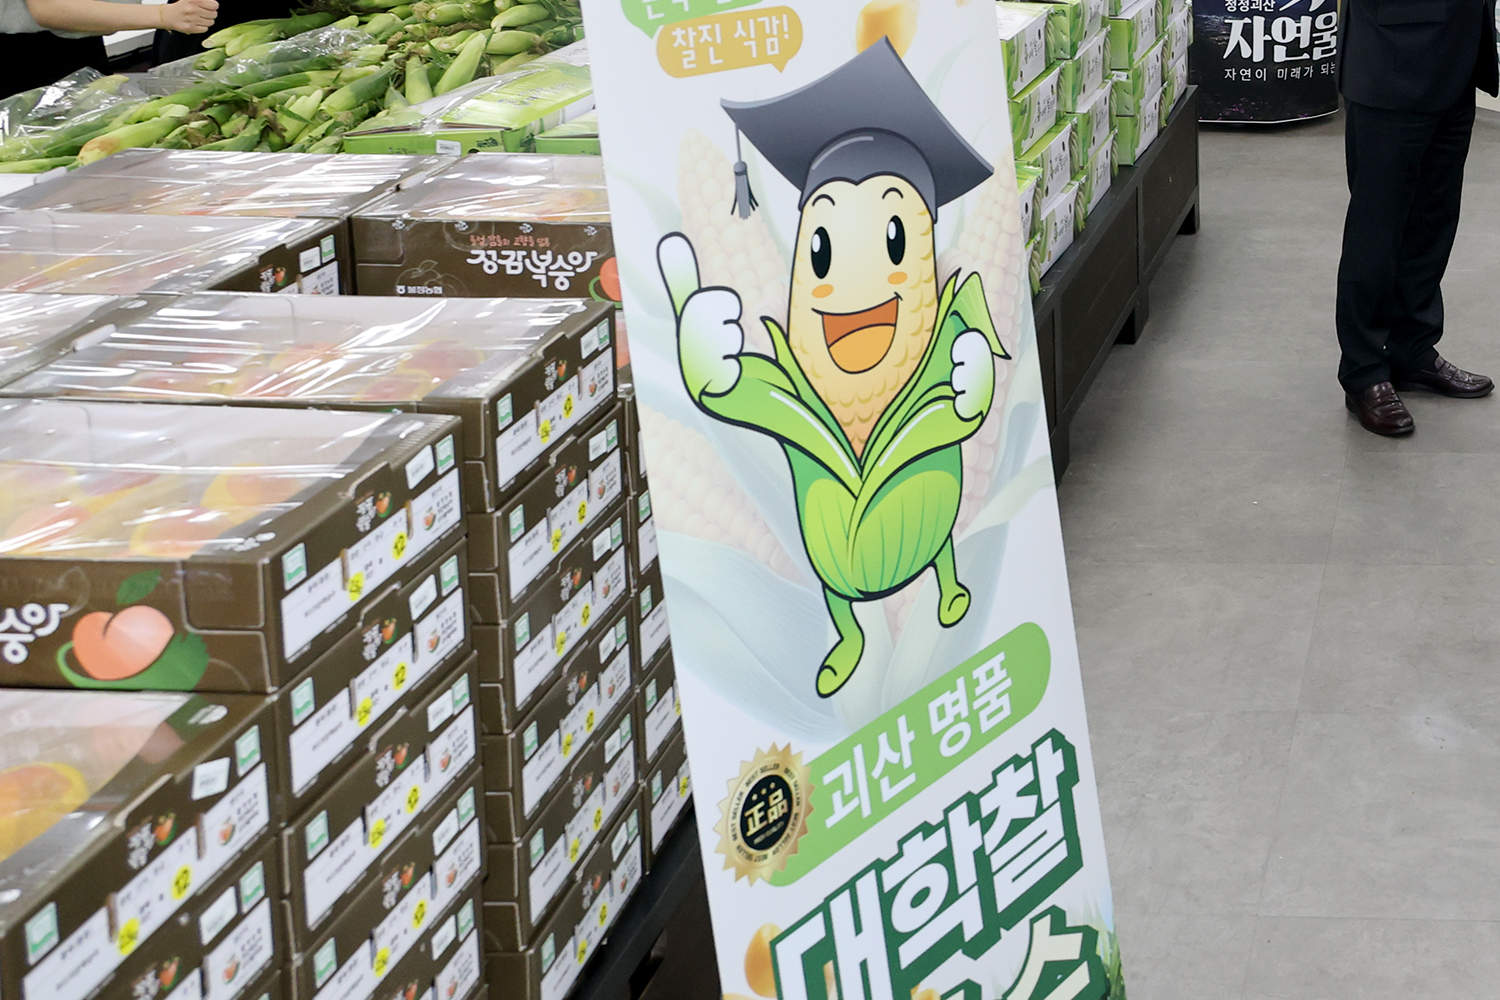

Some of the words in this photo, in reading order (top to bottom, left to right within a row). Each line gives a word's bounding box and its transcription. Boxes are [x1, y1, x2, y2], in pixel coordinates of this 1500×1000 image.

[670, 23, 724, 71] 찰진
[733, 13, 790, 60] 식감!
[1222, 12, 1338, 63] 자연울
[1224, 67, 1267, 82] 자연이
[1277, 65, 1314, 81] 미래가
[821, 714, 917, 830] 괴산
[927, 650, 1014, 758] 명품
[743, 787, 789, 837] 正品
[772, 735, 1072, 1000] 대학찰
